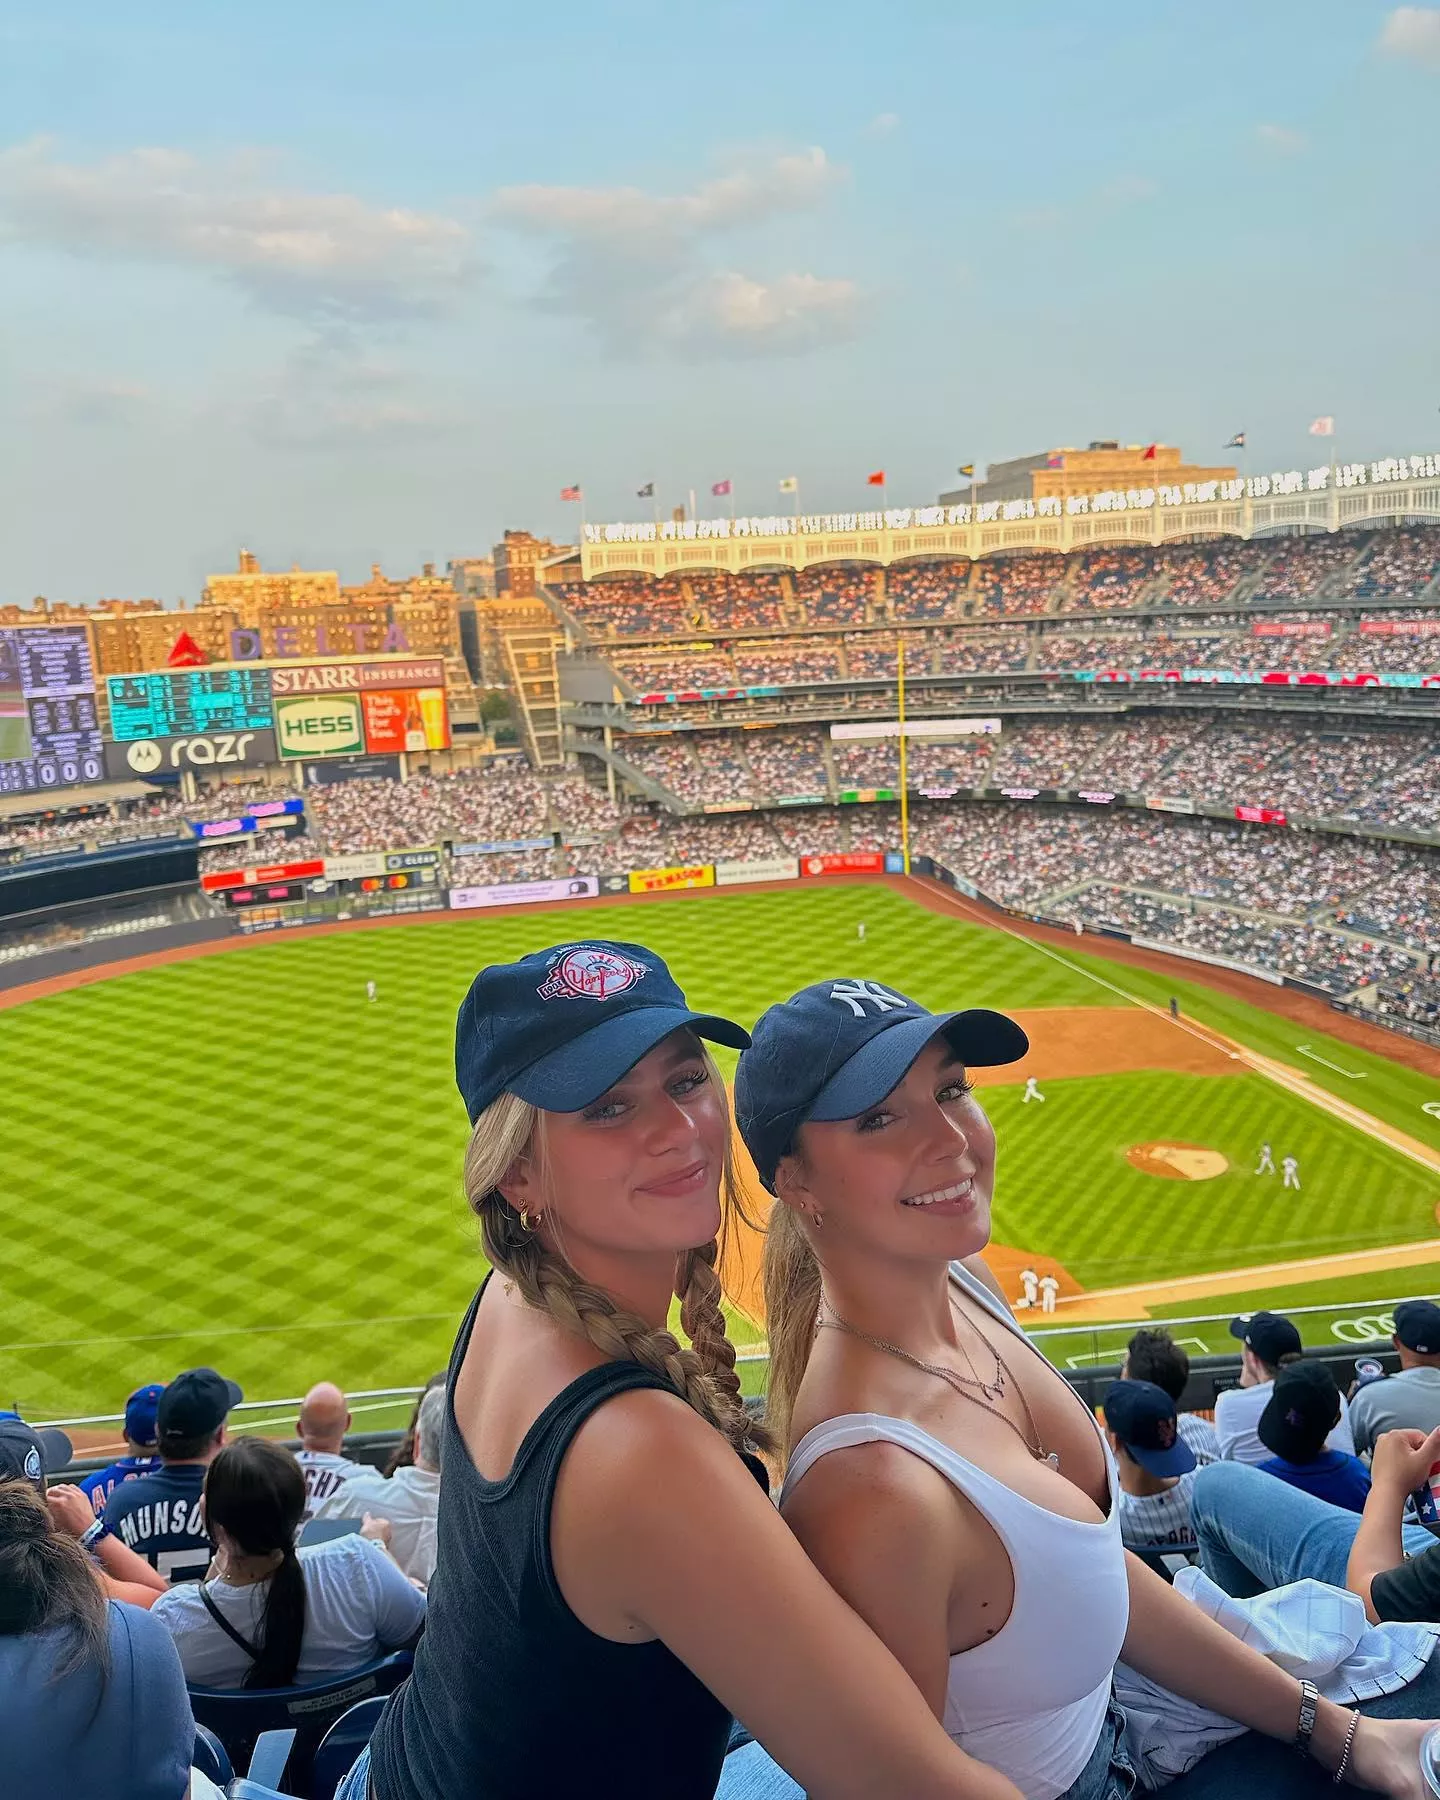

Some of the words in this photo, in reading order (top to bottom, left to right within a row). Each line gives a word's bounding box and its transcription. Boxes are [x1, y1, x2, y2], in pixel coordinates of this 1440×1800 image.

[231, 623, 410, 660] DELTA
[272, 667, 359, 692] STARR
[364, 666, 441, 681] INSURANCE
[285, 715, 353, 737] HESS
[171, 733, 255, 767] razr
[543, 980, 564, 996] 1903
[830, 980, 908, 1018] NY
[304, 1469, 346, 1497] GHT
[119, 1499, 211, 1549] MUNSO
